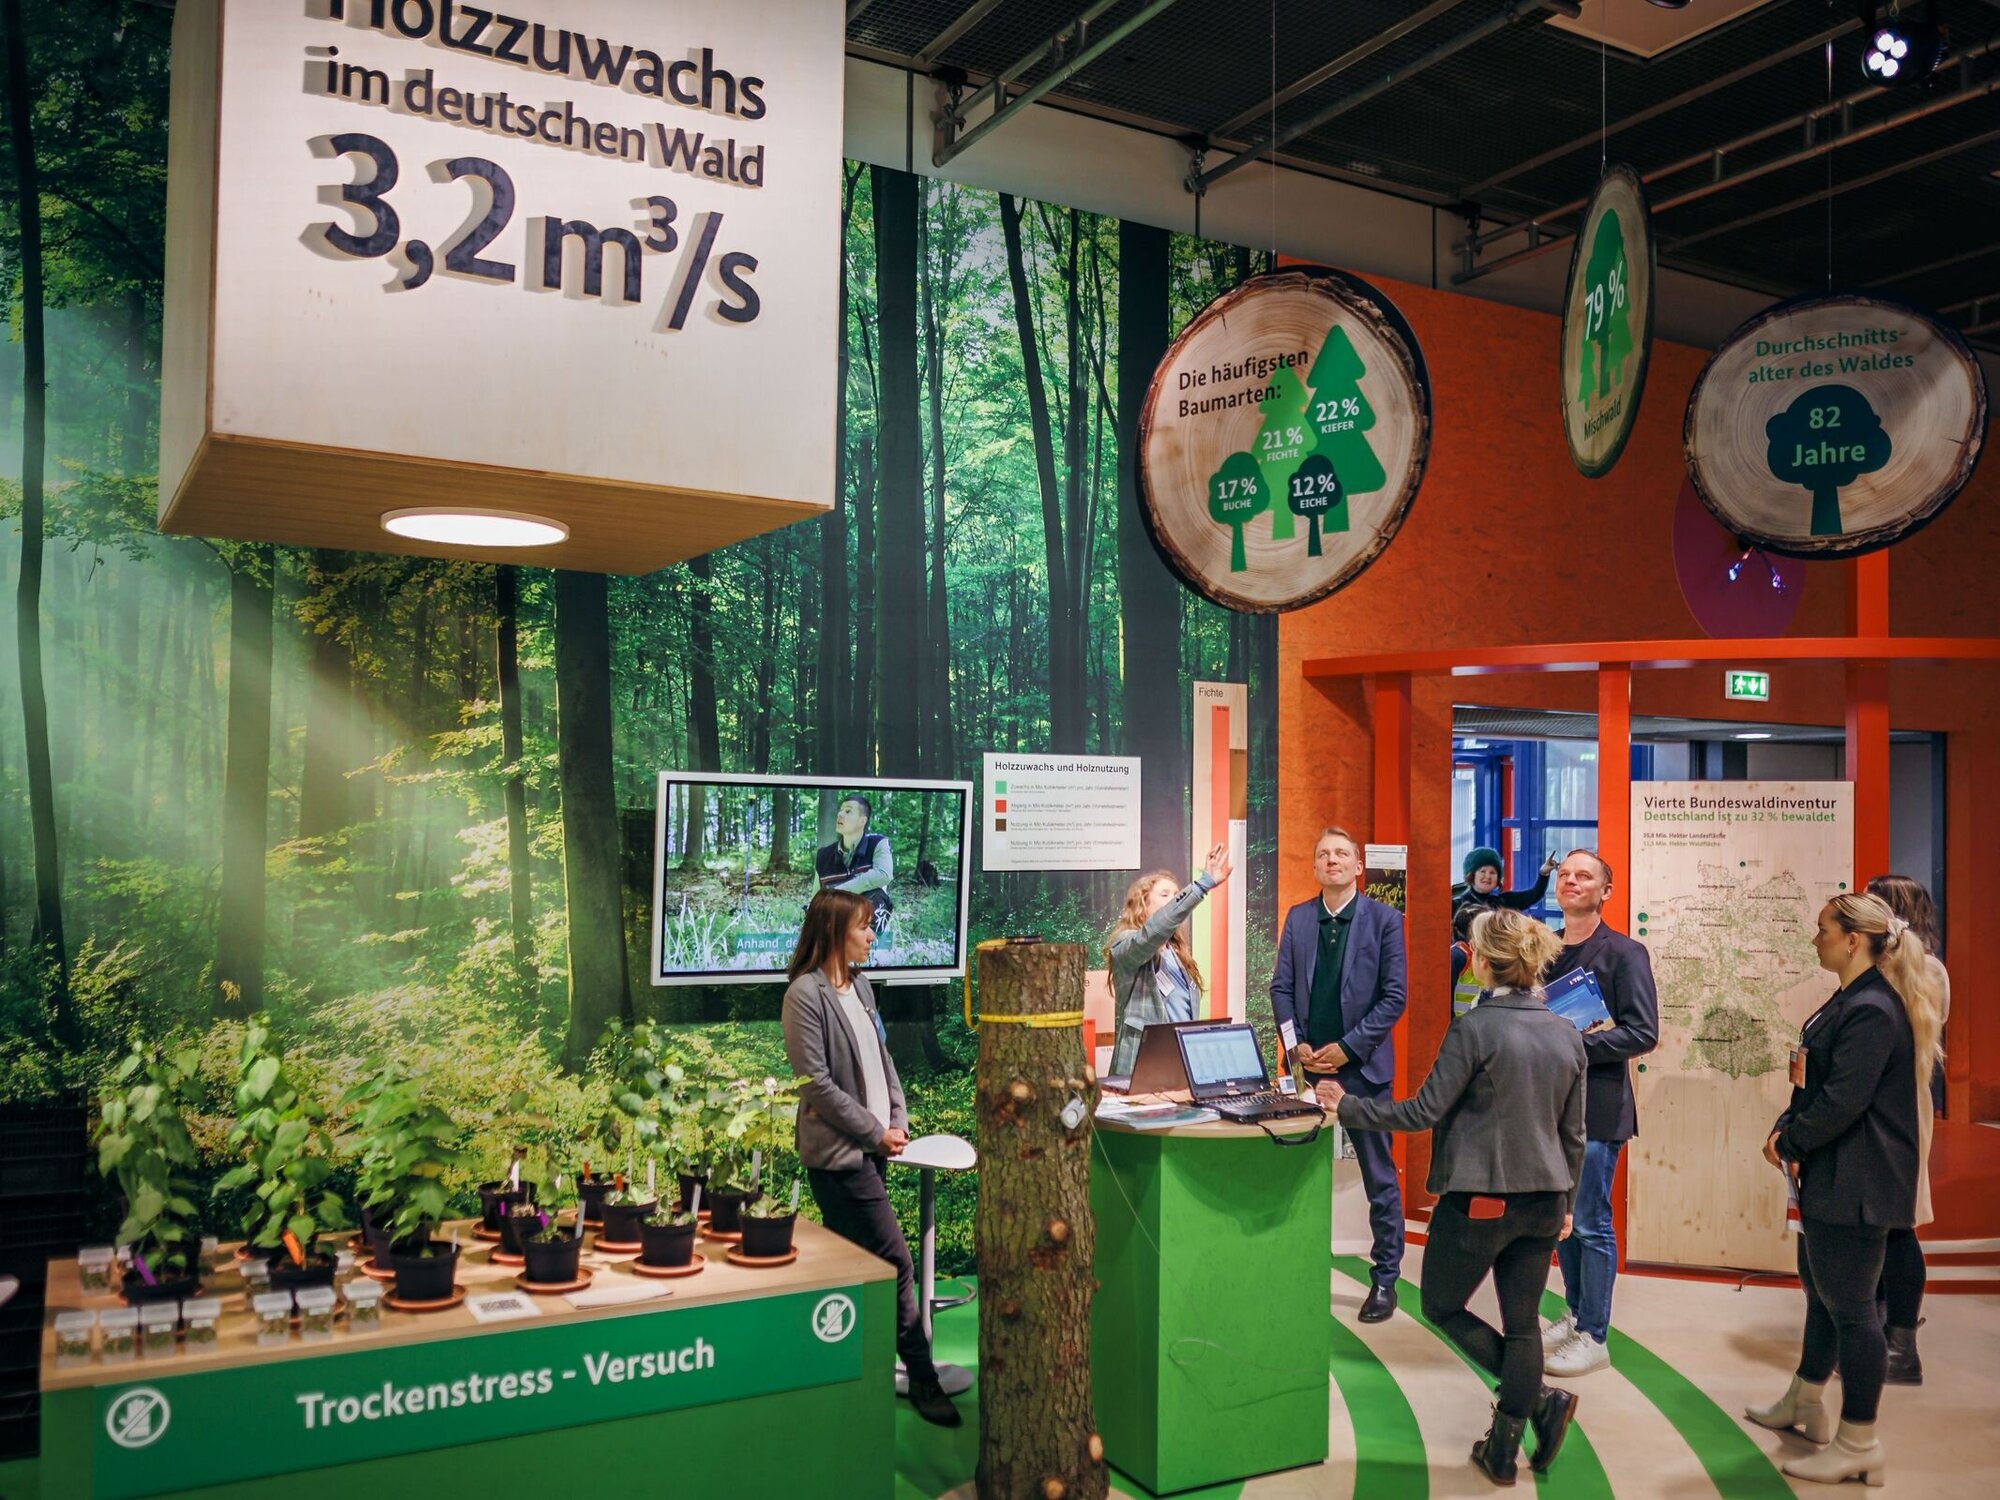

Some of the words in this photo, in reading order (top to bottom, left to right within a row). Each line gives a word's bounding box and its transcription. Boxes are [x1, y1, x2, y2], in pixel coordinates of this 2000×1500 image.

[325, 45, 389, 105] im
[404, 69, 646, 162] deutschen
[656, 121, 765, 189] Wald
[324, 132, 516, 291] 3,2
[543, 195, 761, 331] m³/s
[1584, 283, 1604, 341] 79
[1608, 260, 1625, 317] %
[1755, 328, 1907, 357] Durchschnitts-
[1178, 371, 1207, 391] Die
[1211, 350, 1310, 382] häufigsten
[1748, 359, 1793, 384] alter
[1800, 355, 1834, 378] des
[1839, 352, 1915, 374] Waldes
[1178, 384, 1282, 418] Baumarten:
[1316, 401, 1338, 422] 22
[1341, 397, 1360, 417] %
[1321, 420, 1355, 434] KIEFER
[1584, 394, 1622, 442] Mischwald
[1809, 406, 1841, 429] 82
[1262, 430, 1284, 450] 21
[1286, 426, 1304, 446] %
[1266, 449, 1299, 462] FICHTE
[1791, 441, 1866, 468] Jahre
[1218, 479, 1239, 500] 17
[1240, 476, 1257, 496] %
[1292, 476, 1315, 497] 12
[1317, 473, 1336, 493] %
[1223, 498, 1252, 511] BUCHE
[1299, 496, 1328, 509] EICHE
[1198, 687, 1224, 698] Fichte
[995, 761, 1055, 772] Holzzuwachs
[1057, 763, 1074, 772] und
[1076, 763, 1130, 775] Holznutzung
[1644, 797, 1686, 809] Vierte
[1690, 796, 1837, 809] Bundeswaldinventur
[1644, 811, 1715, 822] Deutschland
[1718, 811, 1731, 822] ist
[1735, 813, 1748, 822] zu
[1751, 812, 1765, 822] 32
[1768, 812, 1778, 822] %
[1781, 811, 1836, 822] bewaldet
[737, 937, 779, 949] Anhand
[296, 1367, 553, 1430] Trockenstress
[562, 1370, 577, 1380] -
[583, 1336, 716, 1387] Versuch
